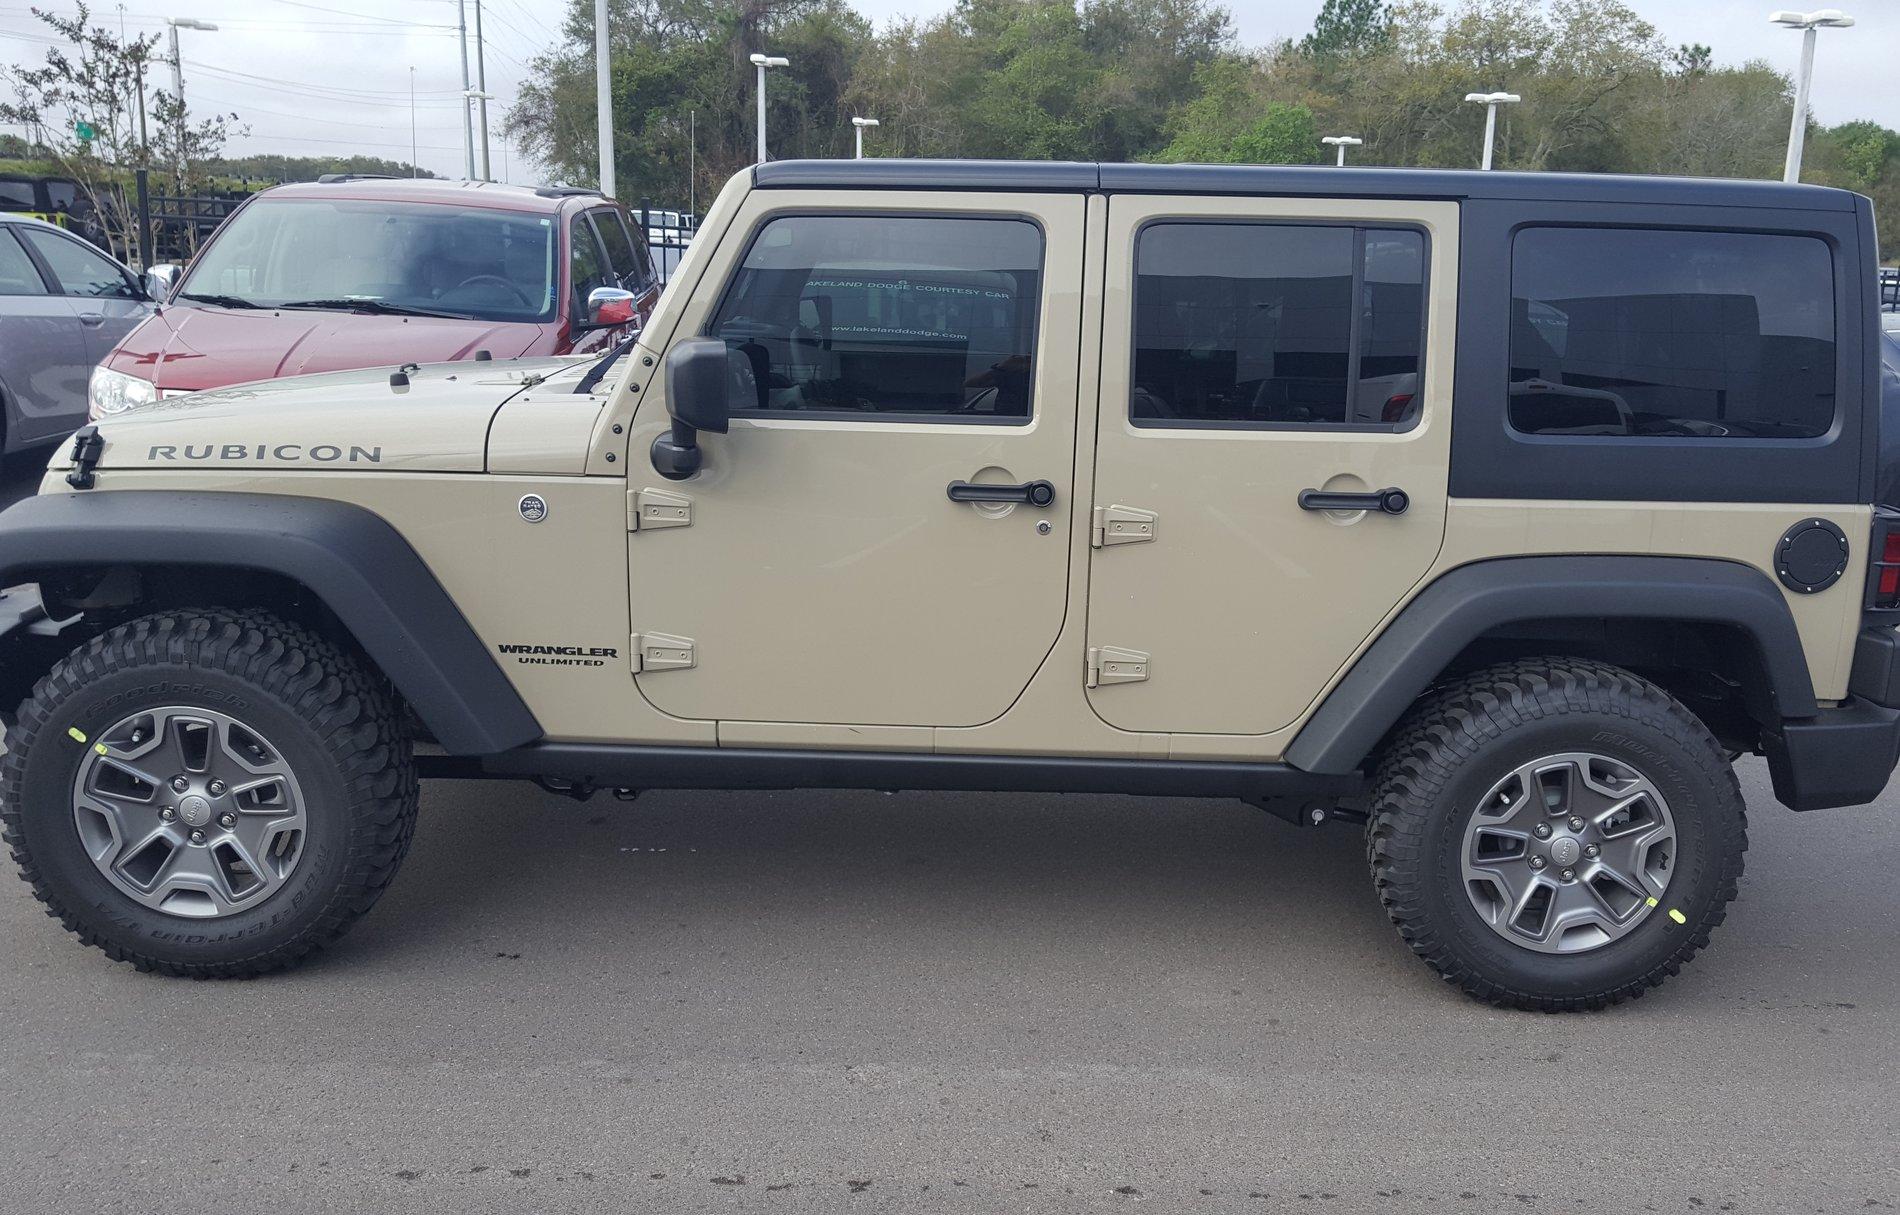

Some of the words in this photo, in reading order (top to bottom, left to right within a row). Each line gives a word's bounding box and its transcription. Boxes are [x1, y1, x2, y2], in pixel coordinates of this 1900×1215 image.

[867, 282, 911, 290] DODGE
[915, 285, 980, 295] COURTESY
[985, 291, 1010, 299] CAR
[832, 326, 967, 340] ww.lakelanddodge.com
[148, 445, 382, 462] RUBICON
[498, 645, 618, 658] WRANGLER
[519, 658, 604, 666] UNLIMITED
